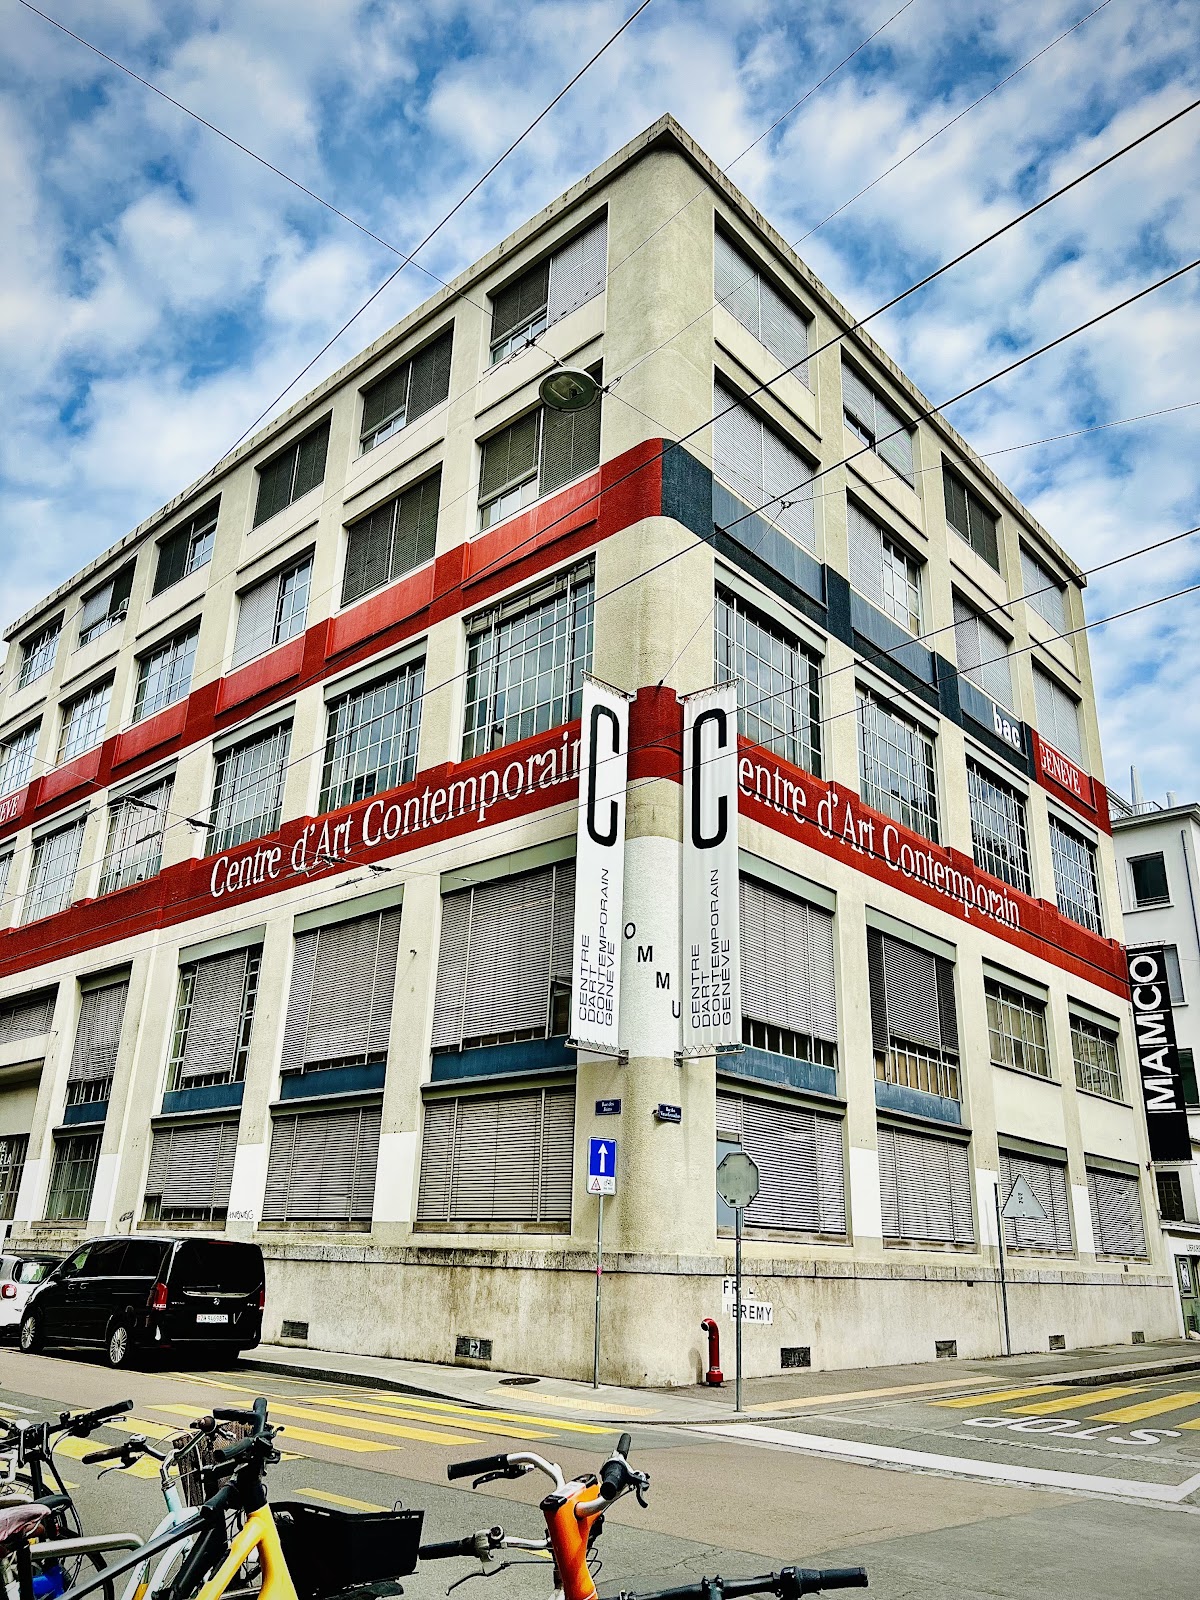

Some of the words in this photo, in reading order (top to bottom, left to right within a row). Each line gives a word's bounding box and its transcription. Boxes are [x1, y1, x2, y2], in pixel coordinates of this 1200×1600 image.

[993, 703, 1021, 749] bac
[210, 846, 282, 897] Centre
[291, 814, 354, 872] d'Art
[738, 755, 807, 825] entre
[817, 790, 875, 859] d'Art
[883, 824, 1021, 931] Contemporain
[579, 934, 590, 1021] CENTRE
[596, 868, 609, 1025] CONTEMPORAIN
[691, 944, 701, 1029] CENTRE
[710, 869, 721, 1026] CONTEMPORAIN
[1129, 954, 1179, 1112] MAMCO
[962, 1415, 1182, 1446] STOP
